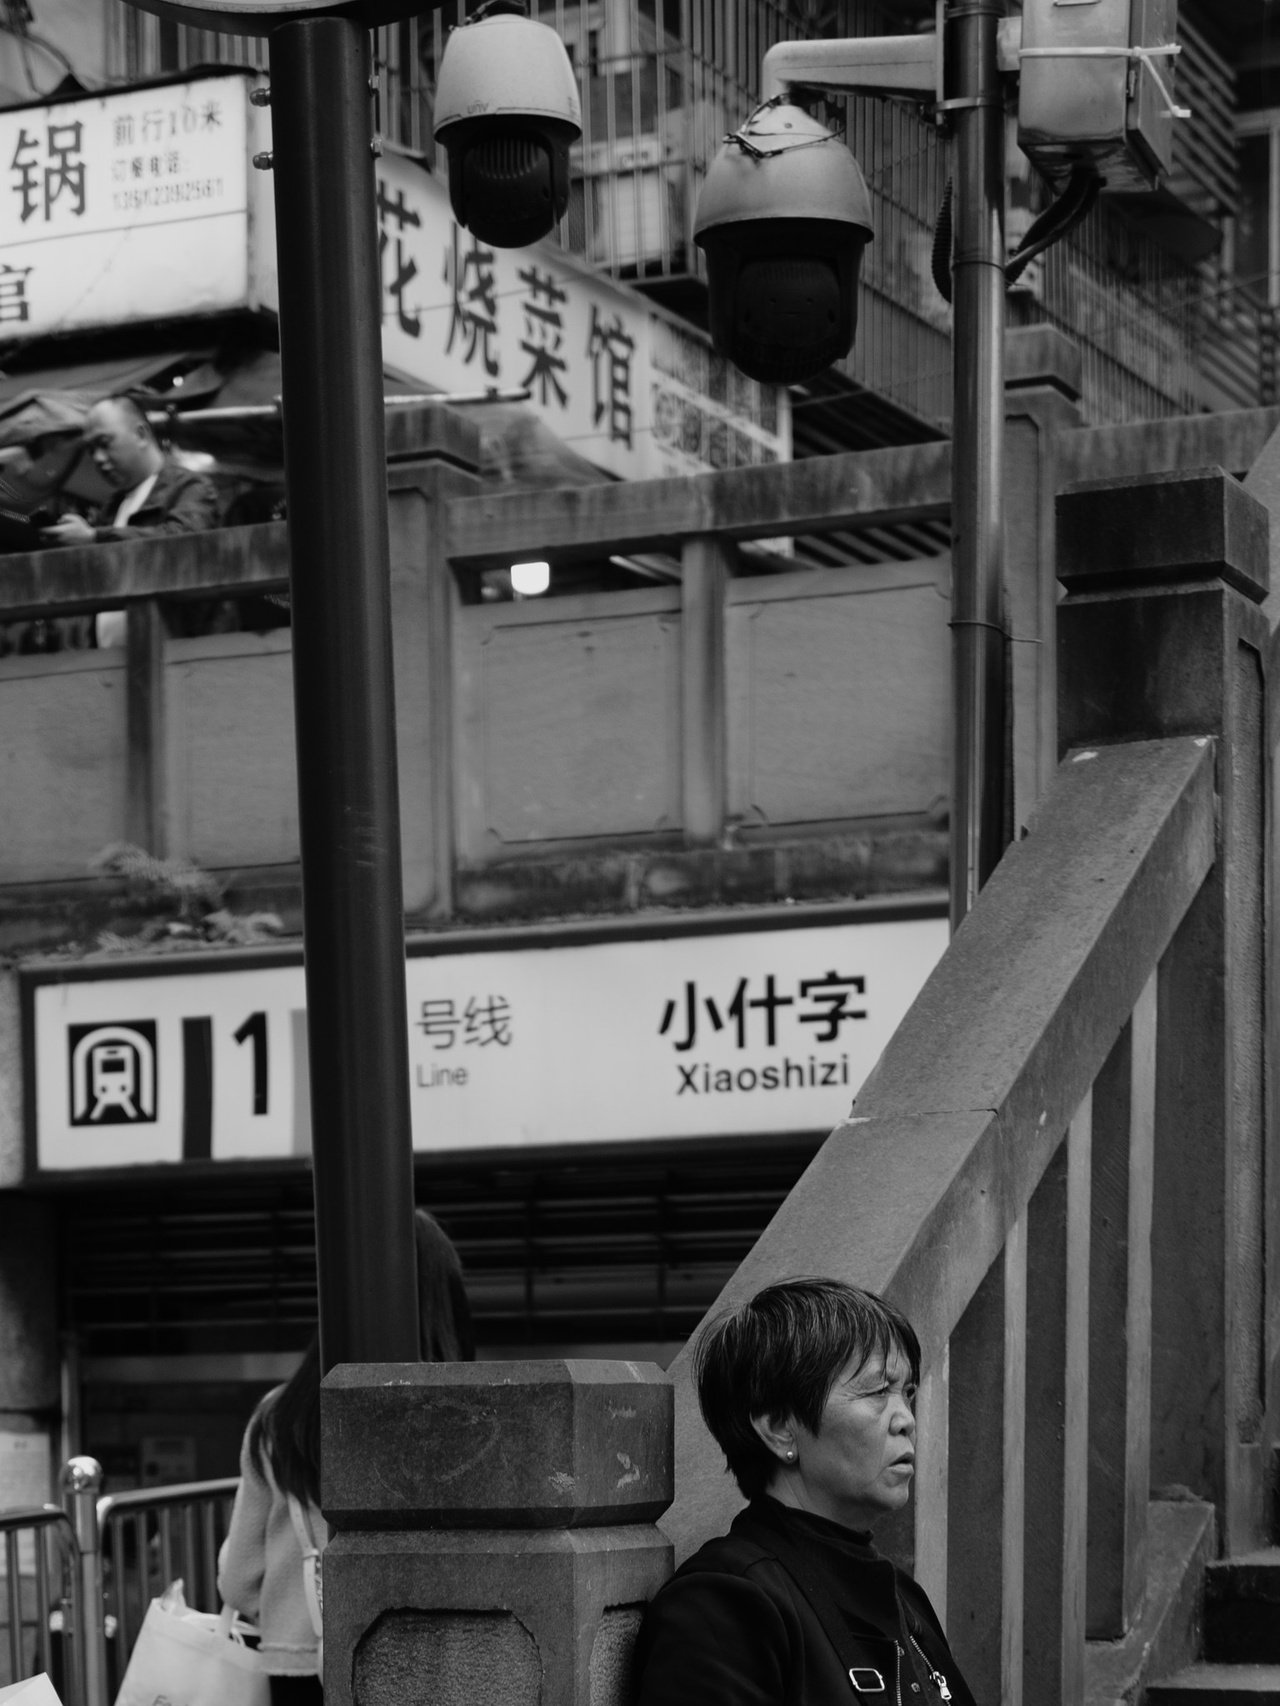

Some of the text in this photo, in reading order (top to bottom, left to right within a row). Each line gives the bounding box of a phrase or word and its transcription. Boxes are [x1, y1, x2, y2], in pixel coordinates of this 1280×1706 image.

[11, 121, 86, 223] 锅
[658, 969, 868, 1052] 小什字
[232, 994, 513, 1116] 1 号线
[415, 1062, 468, 1089] Line
[676, 1052, 849, 1096] Xiaoshizi
